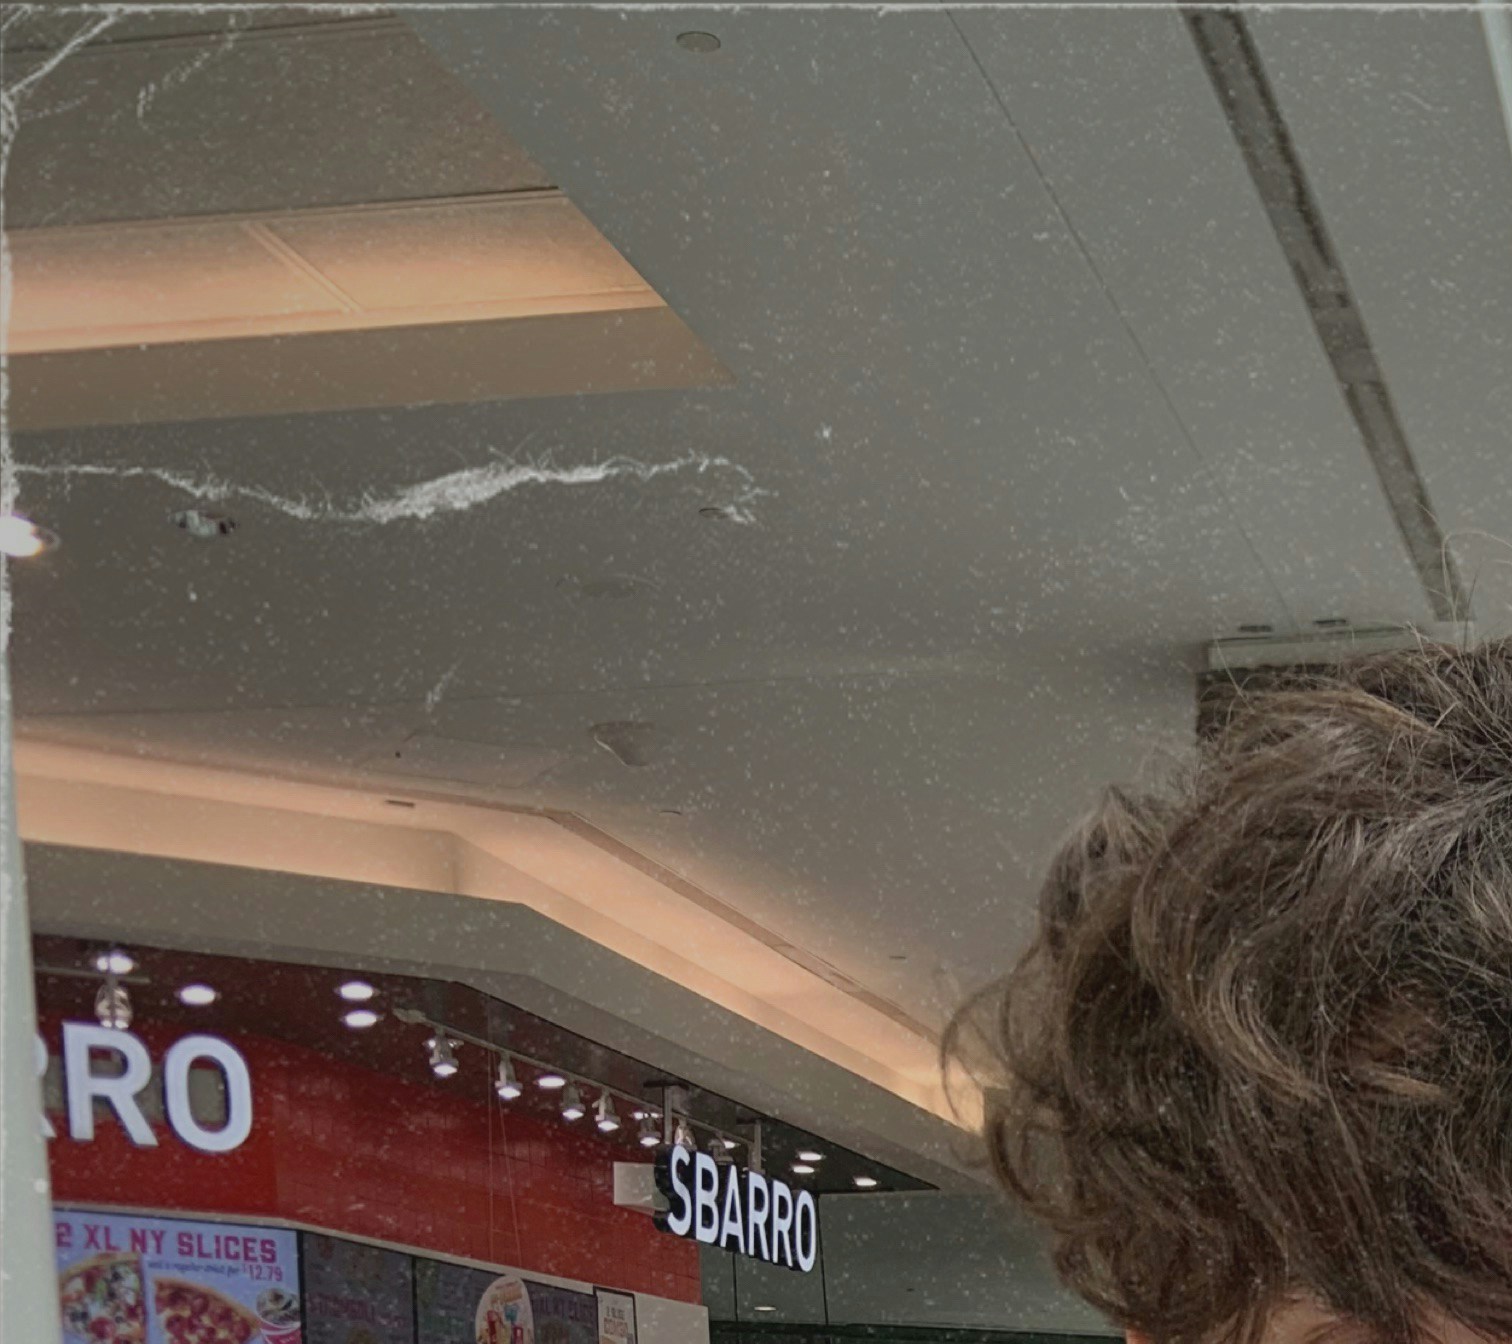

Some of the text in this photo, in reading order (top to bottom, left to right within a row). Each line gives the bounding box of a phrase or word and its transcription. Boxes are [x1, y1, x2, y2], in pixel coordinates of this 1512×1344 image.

[34, 1021, 253, 1155] RO
[84, 1223, 121, 1253] XL
[130, 1227, 167, 1255] NY
[176, 1231, 277, 1264] SLICES
[667, 1145, 816, 1273] SBARRO
